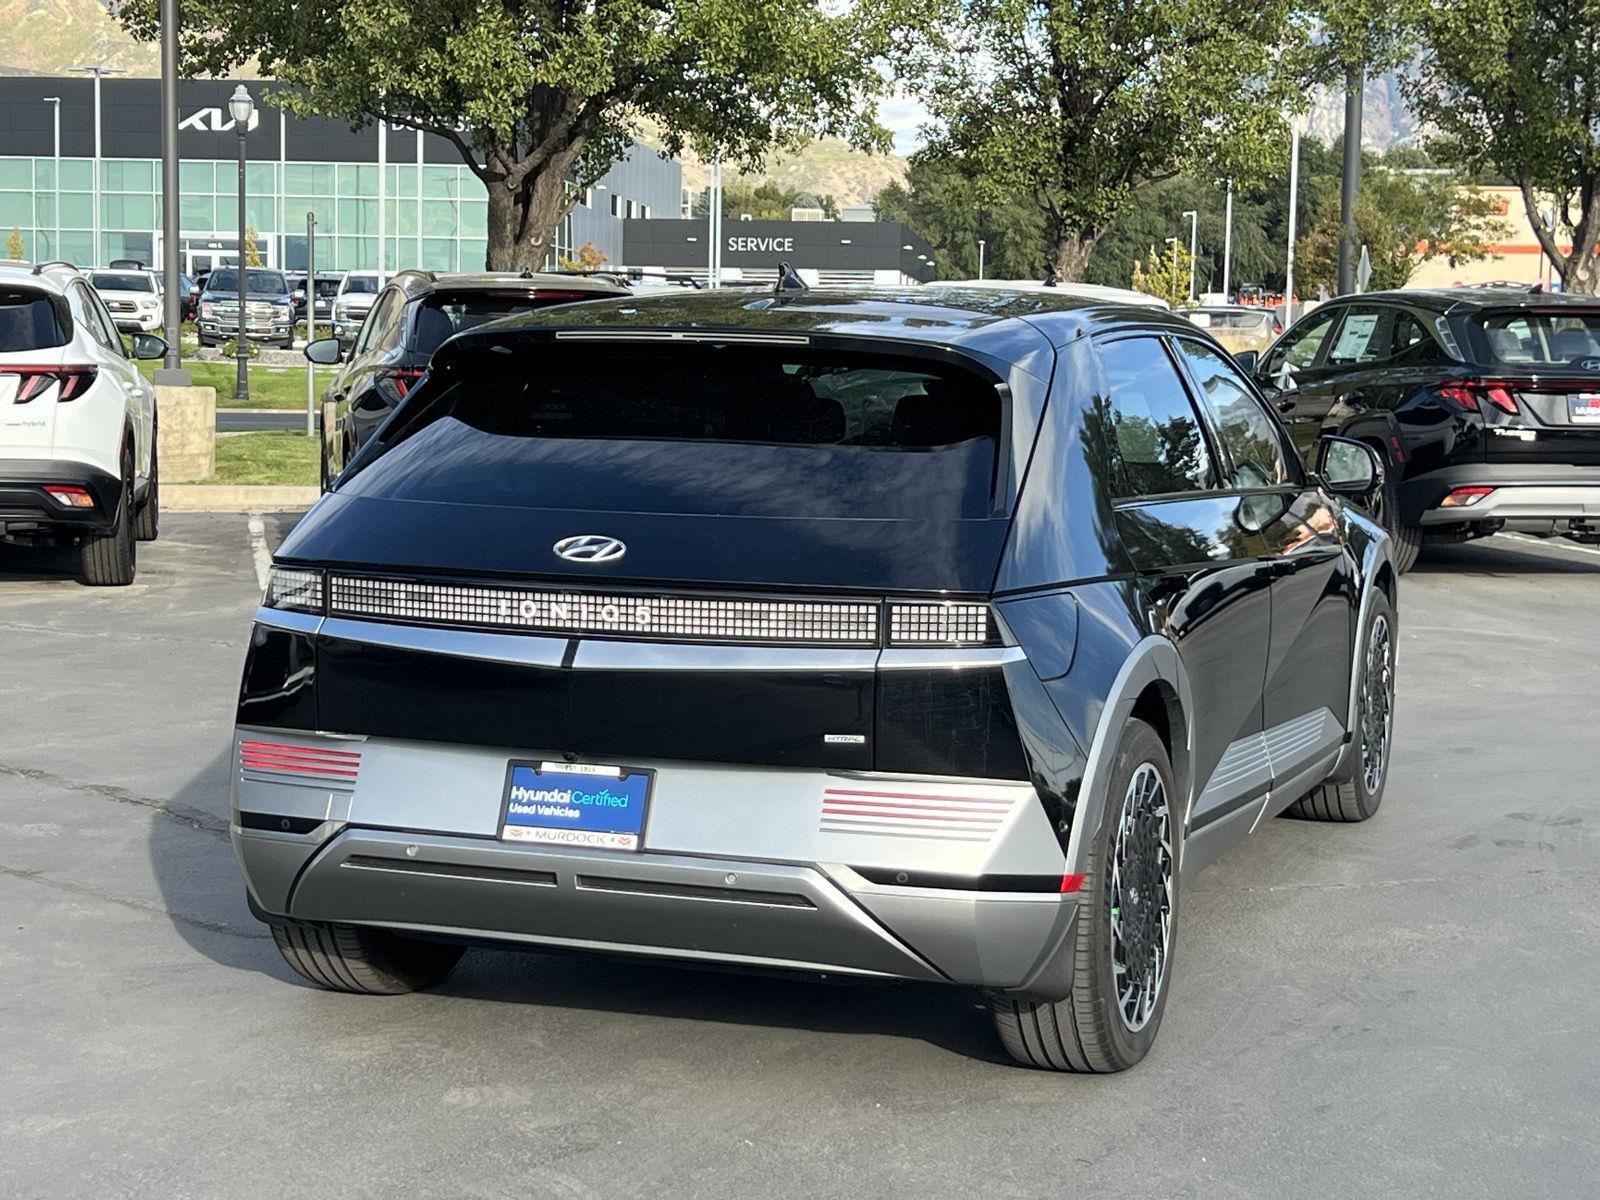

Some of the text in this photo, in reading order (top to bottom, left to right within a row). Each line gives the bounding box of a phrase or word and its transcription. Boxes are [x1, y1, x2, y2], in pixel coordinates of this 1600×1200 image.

[728, 236, 794, 253] SERVICE
[498, 599, 652, 625] IONIQ 5
[510, 786, 629, 808] Hyundai Certified
[509, 802, 581, 818] Used Vehicles
[534, 830, 606, 845] MURDOCK
